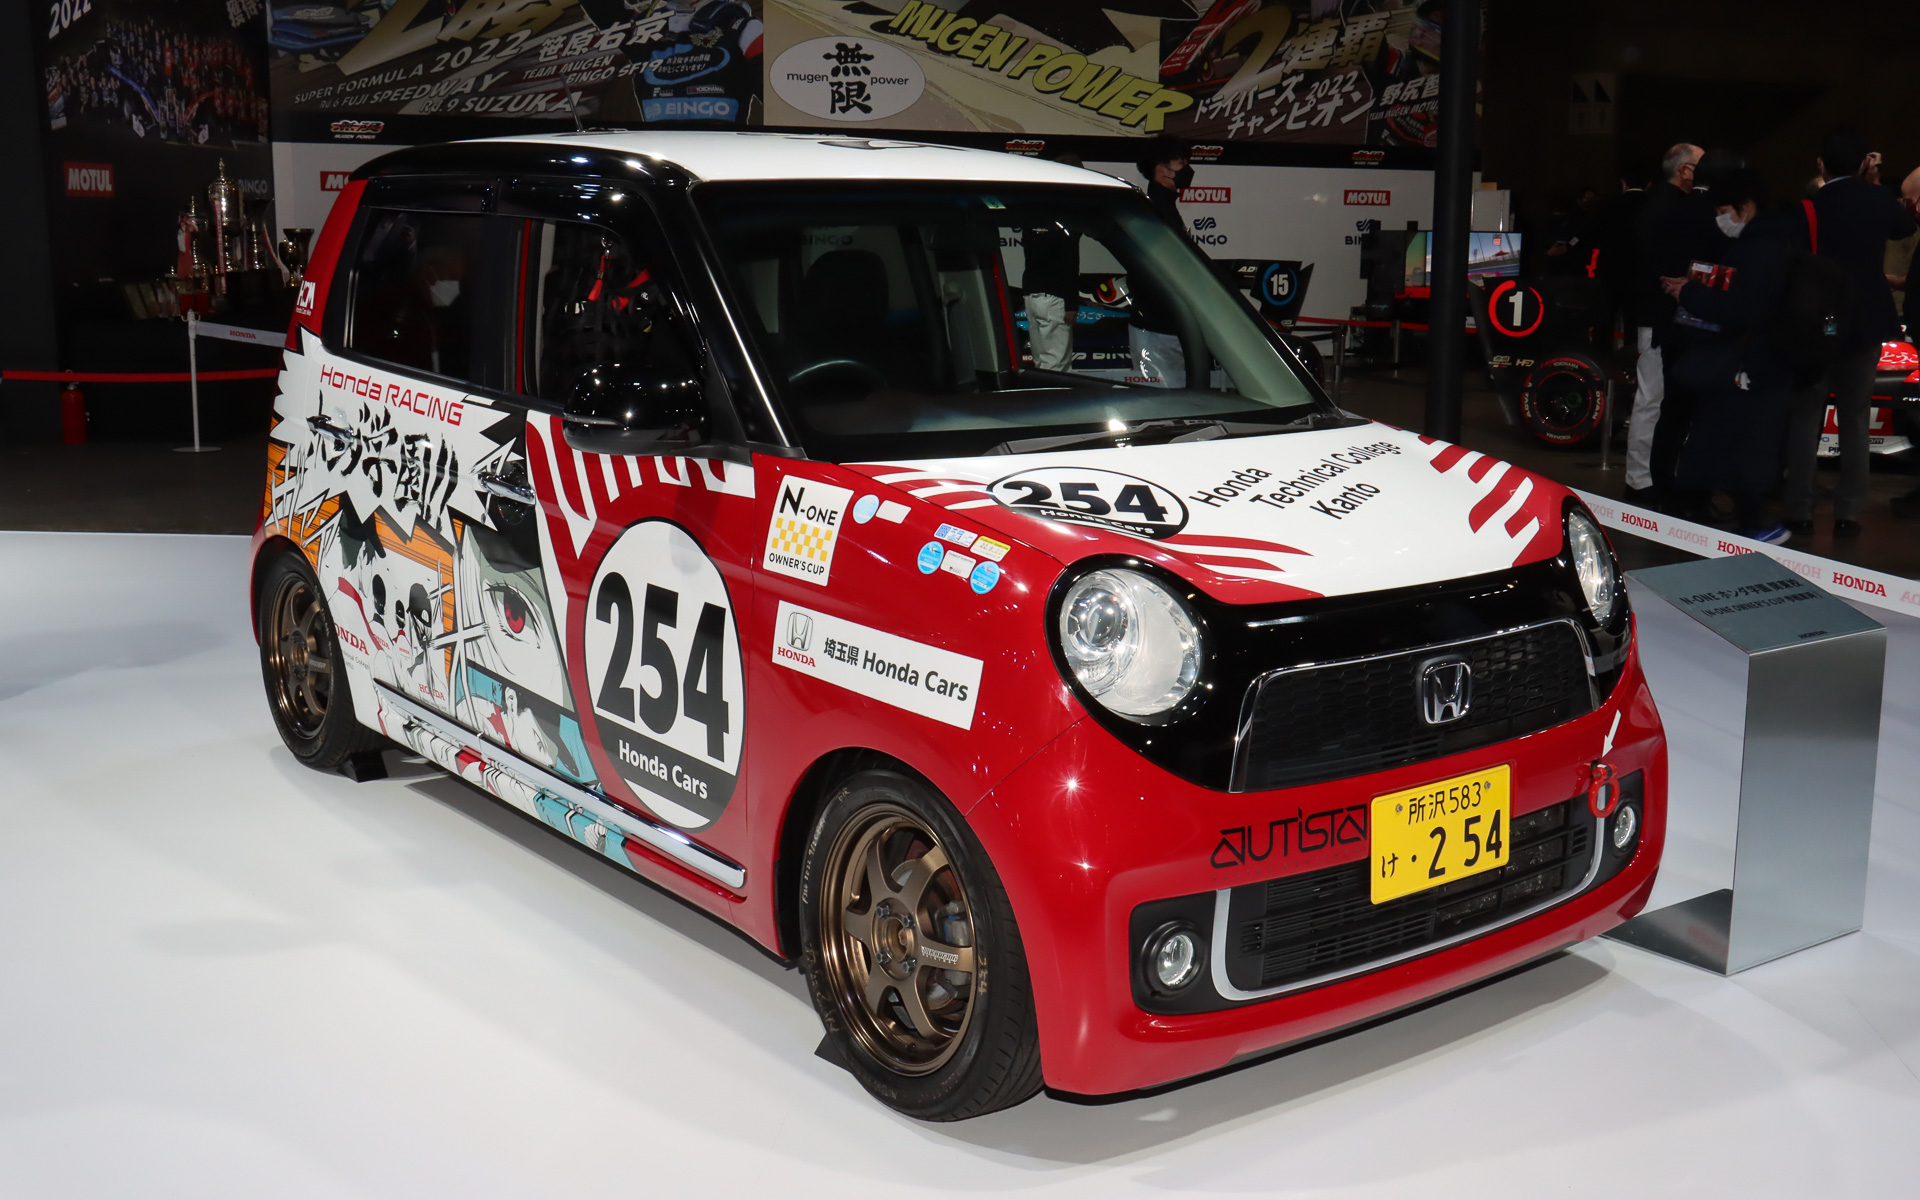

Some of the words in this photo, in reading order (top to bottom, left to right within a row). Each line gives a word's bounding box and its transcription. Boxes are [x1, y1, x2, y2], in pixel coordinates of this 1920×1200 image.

[538, 10, 676, 62] 笹原右京
[295, 86, 332, 104] SUPER
[338, 63, 424, 93] FORMULA
[430, 29, 532, 74] 2022
[523, 65, 557, 80] TEAM
[558, 55, 615, 76] MUGEN
[618, 59, 664, 79] SF19
[786, 72, 829, 84] mugen
[823, 42, 875, 115] 無限
[870, 76, 909, 86] power
[889, 0, 1028, 73] MUGEN
[1007, 43, 1194, 135] POWER
[341, 92, 367, 107] FUJI
[371, 70, 510, 104] SPEEDWAY
[1194, 73, 1305, 124] ドライバーズ
[1305, 70, 1359, 101] 2022
[461, 90, 583, 114] SUZUKA
[666, 101, 731, 116] BINGO
[1227, 91, 1377, 140] チャンピオン
[1410, 101, 1440, 116] MOTU
[67, 167, 114, 192] MOTUL
[1181, 189, 1229, 202] MOTUL
[1347, 191, 1389, 204] MOTUL
[1270, 273, 1289, 297] 15
[1508, 291, 1524, 327] 1
[229, 330, 257, 340] HONDA
[320, 363, 383, 401] Honda
[384, 383, 465, 426] RACING
[1189, 467, 1273, 508] Honda
[1248, 458, 1351, 509] Technical
[1330, 441, 1402, 465] College
[779, 484, 838, 526] N-ONE
[1002, 480, 1169, 523] 254
[1309, 482, 1381, 520] Kanto
[1040, 509, 1108, 527] Honda
[1111, 519, 1156, 535] Cars
[1620, 512, 1660, 533] HONDA
[768, 552, 807, 572] OWNER'S
[806, 562, 825, 576] CUP
[1831, 571, 1888, 598] HONDA
[595, 571, 730, 763] 254
[777, 646, 817, 668] HONDA
[823, 637, 859, 666] 埼玉県
[862, 649, 920, 687] Honda
[924, 670, 969, 702] Cars
[618, 739, 668, 781] Honda
[671, 764, 709, 800] Cars
